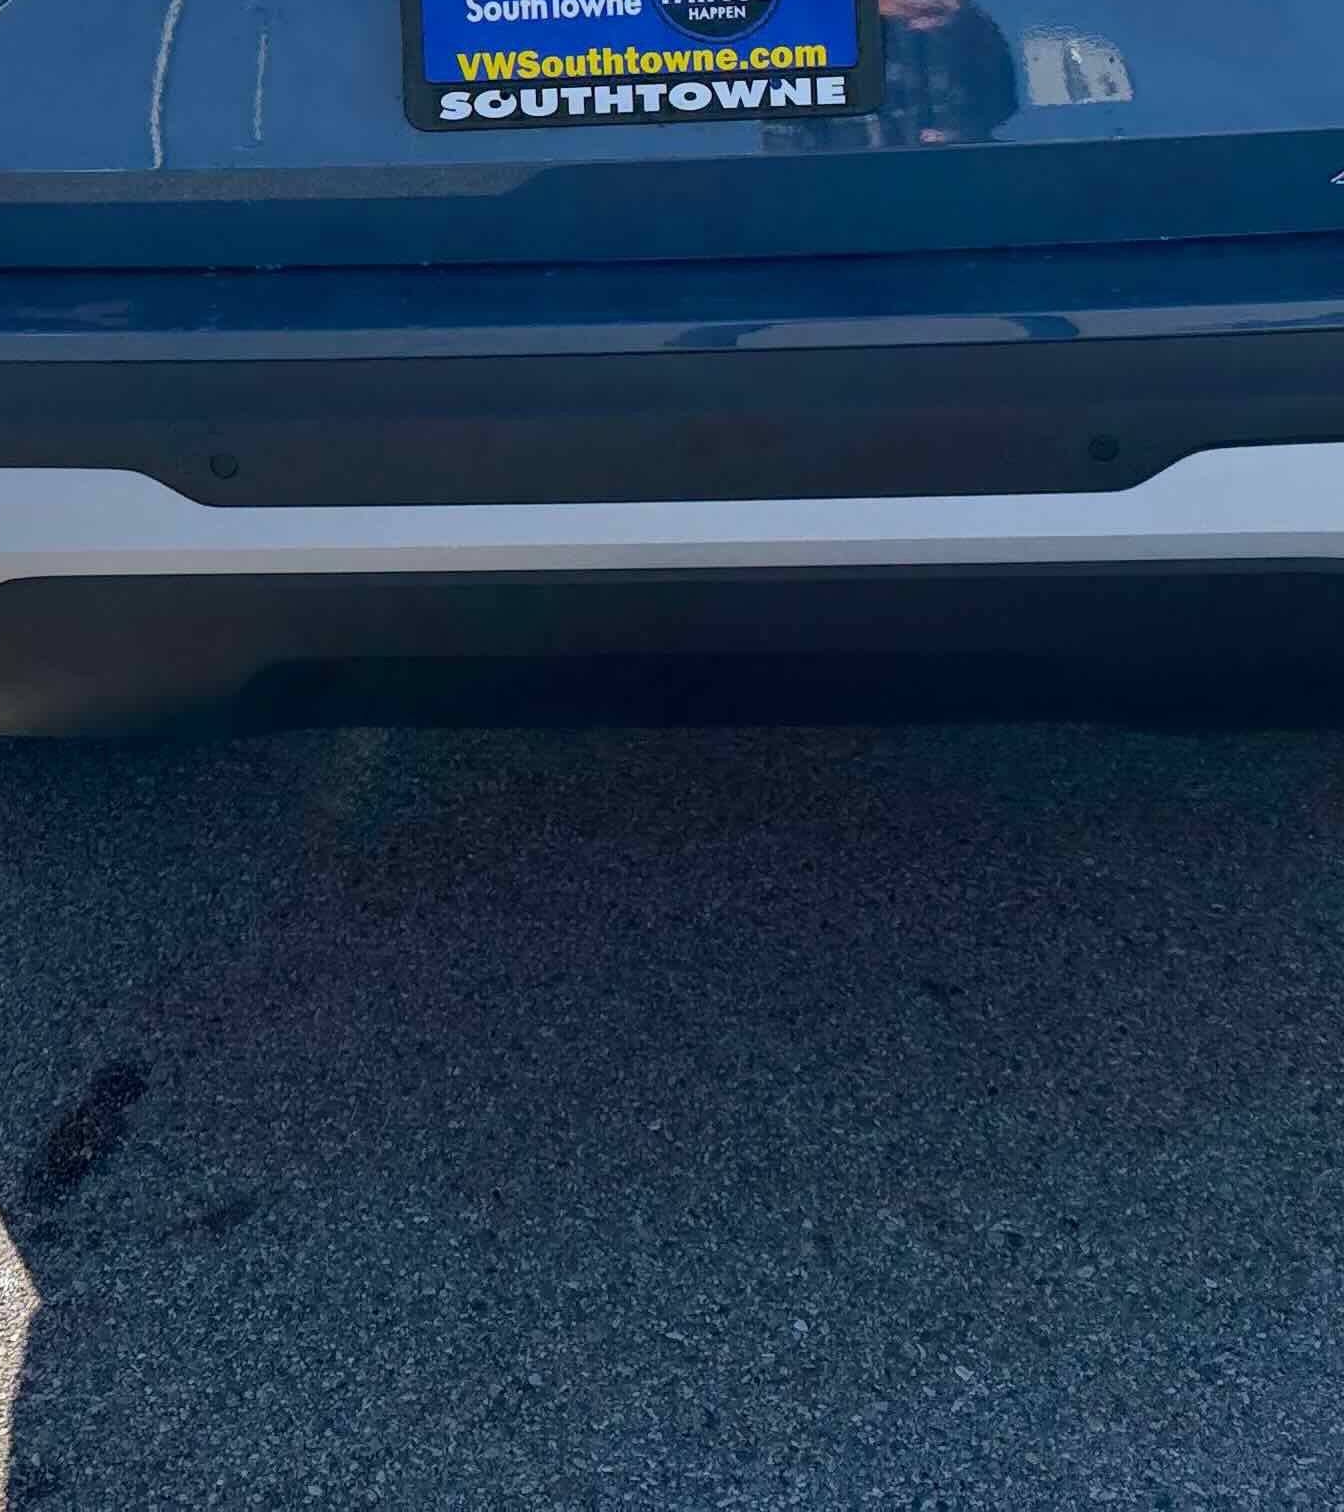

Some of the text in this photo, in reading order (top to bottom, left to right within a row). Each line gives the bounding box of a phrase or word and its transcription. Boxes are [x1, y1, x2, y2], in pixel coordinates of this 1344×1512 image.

[688, 5, 747, 21] HAPPEN
[456, 43, 828, 82] VWSouthtowne.com
[439, 76, 847, 122] SOUTHTOWNE
